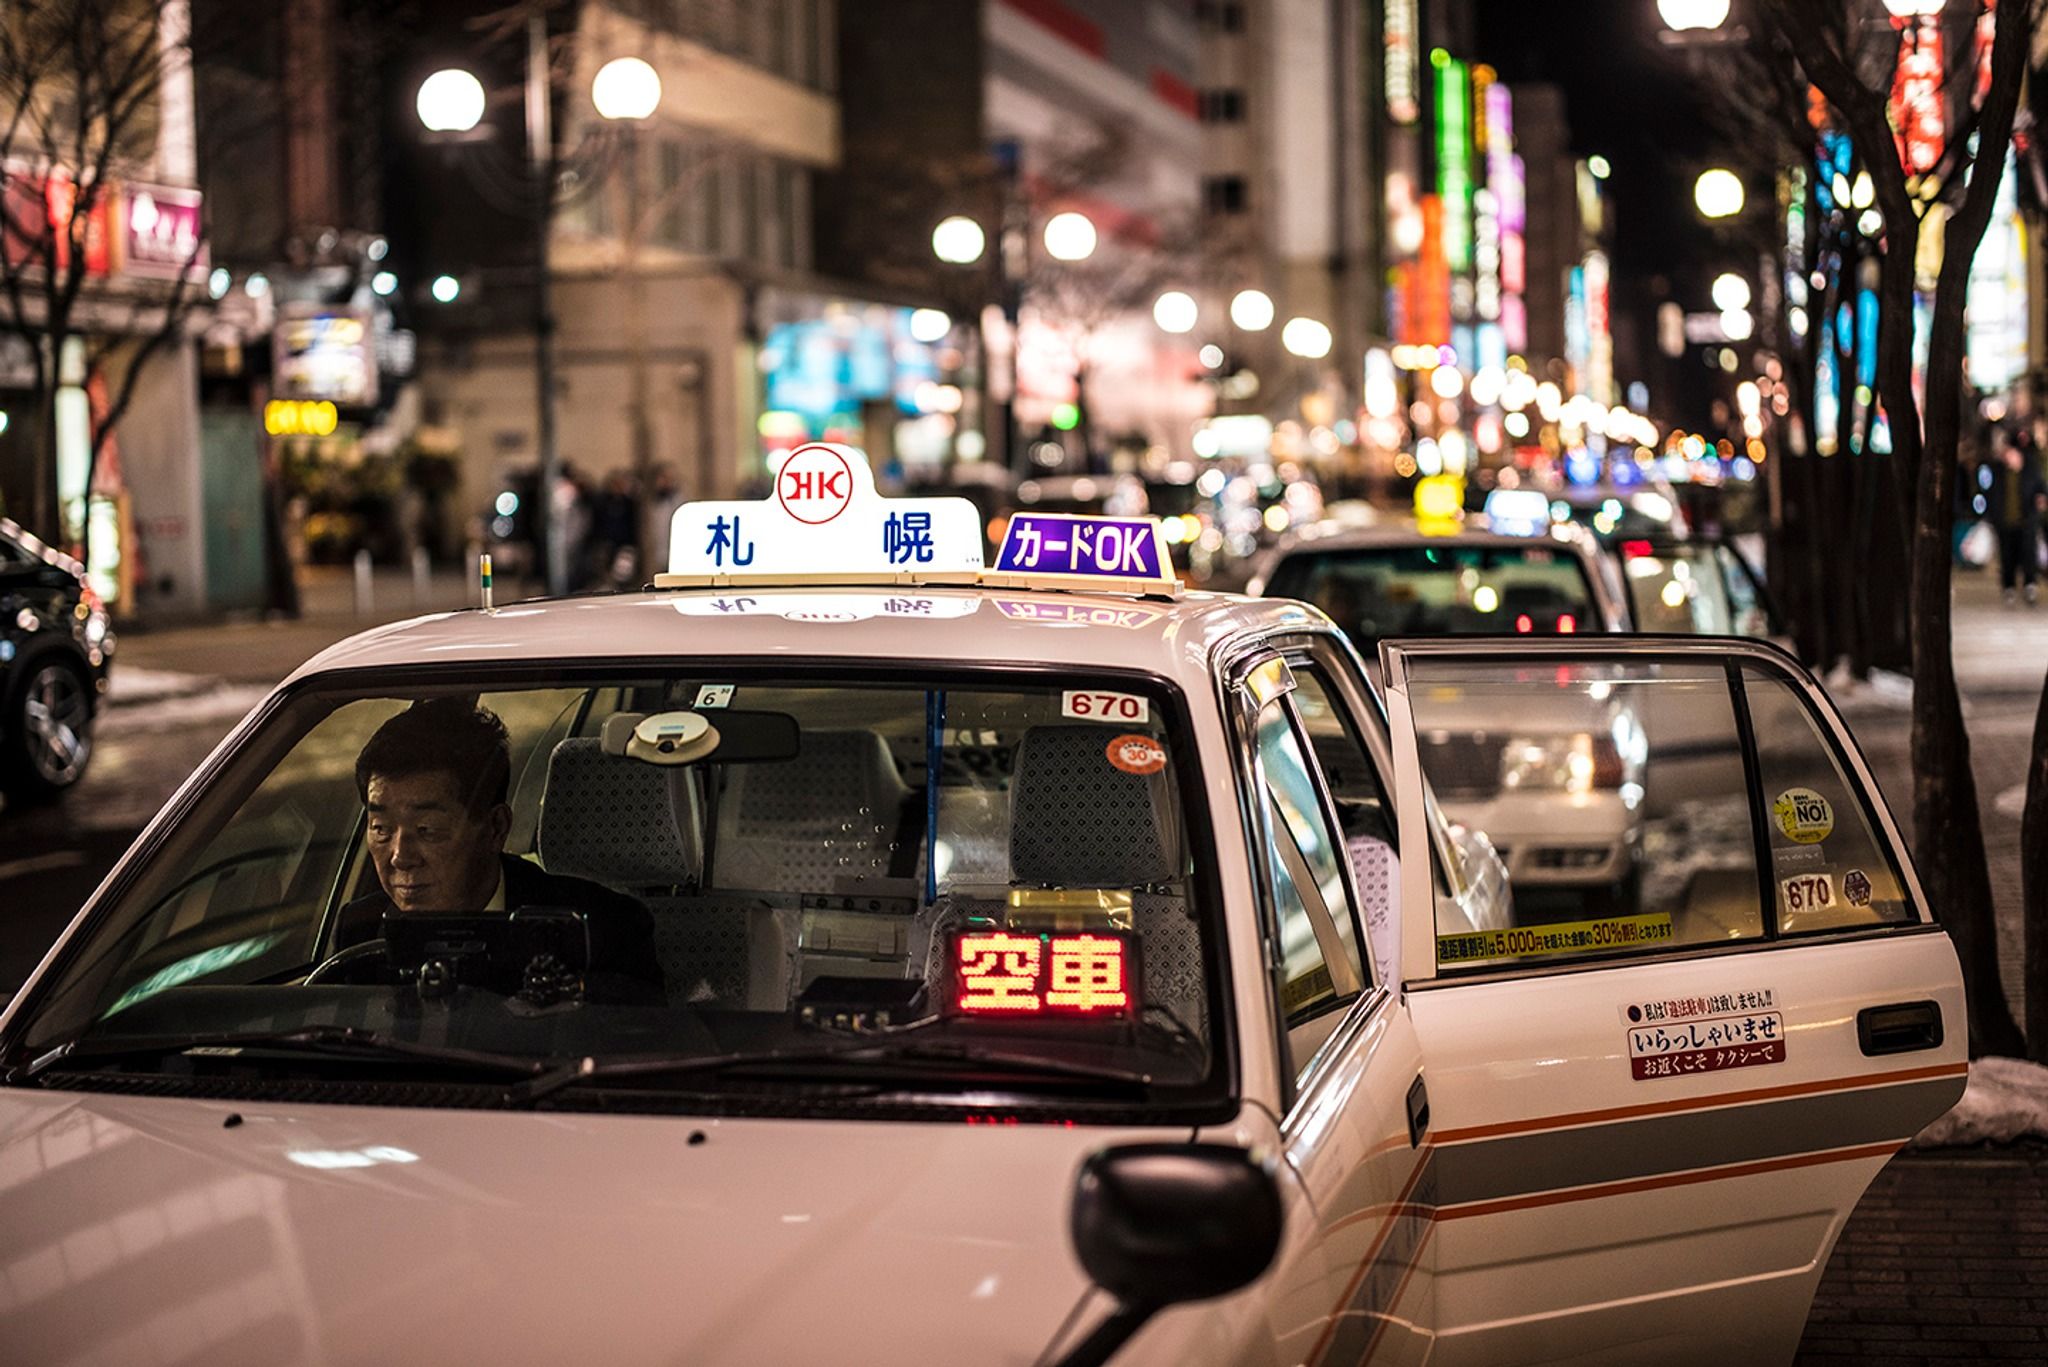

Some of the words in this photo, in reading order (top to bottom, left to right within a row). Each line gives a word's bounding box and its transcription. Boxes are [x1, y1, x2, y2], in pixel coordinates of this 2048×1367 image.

[705, 514, 755, 567] 札
[882, 510, 935, 565] 幌
[1012, 521, 1150, 574] カードOK
[703, 691, 716, 706] 6
[1071, 693, 1140, 718] 670
[1127, 749, 1148, 761] 30
[1797, 804, 1829, 823] NO!
[1787, 878, 1830, 909] 670
[960, 933, 1128, 1012] 空車
[1634, 1016, 1777, 1053] いらっしゃいませ
[1715, 1045, 1775, 1068] タクシーで
